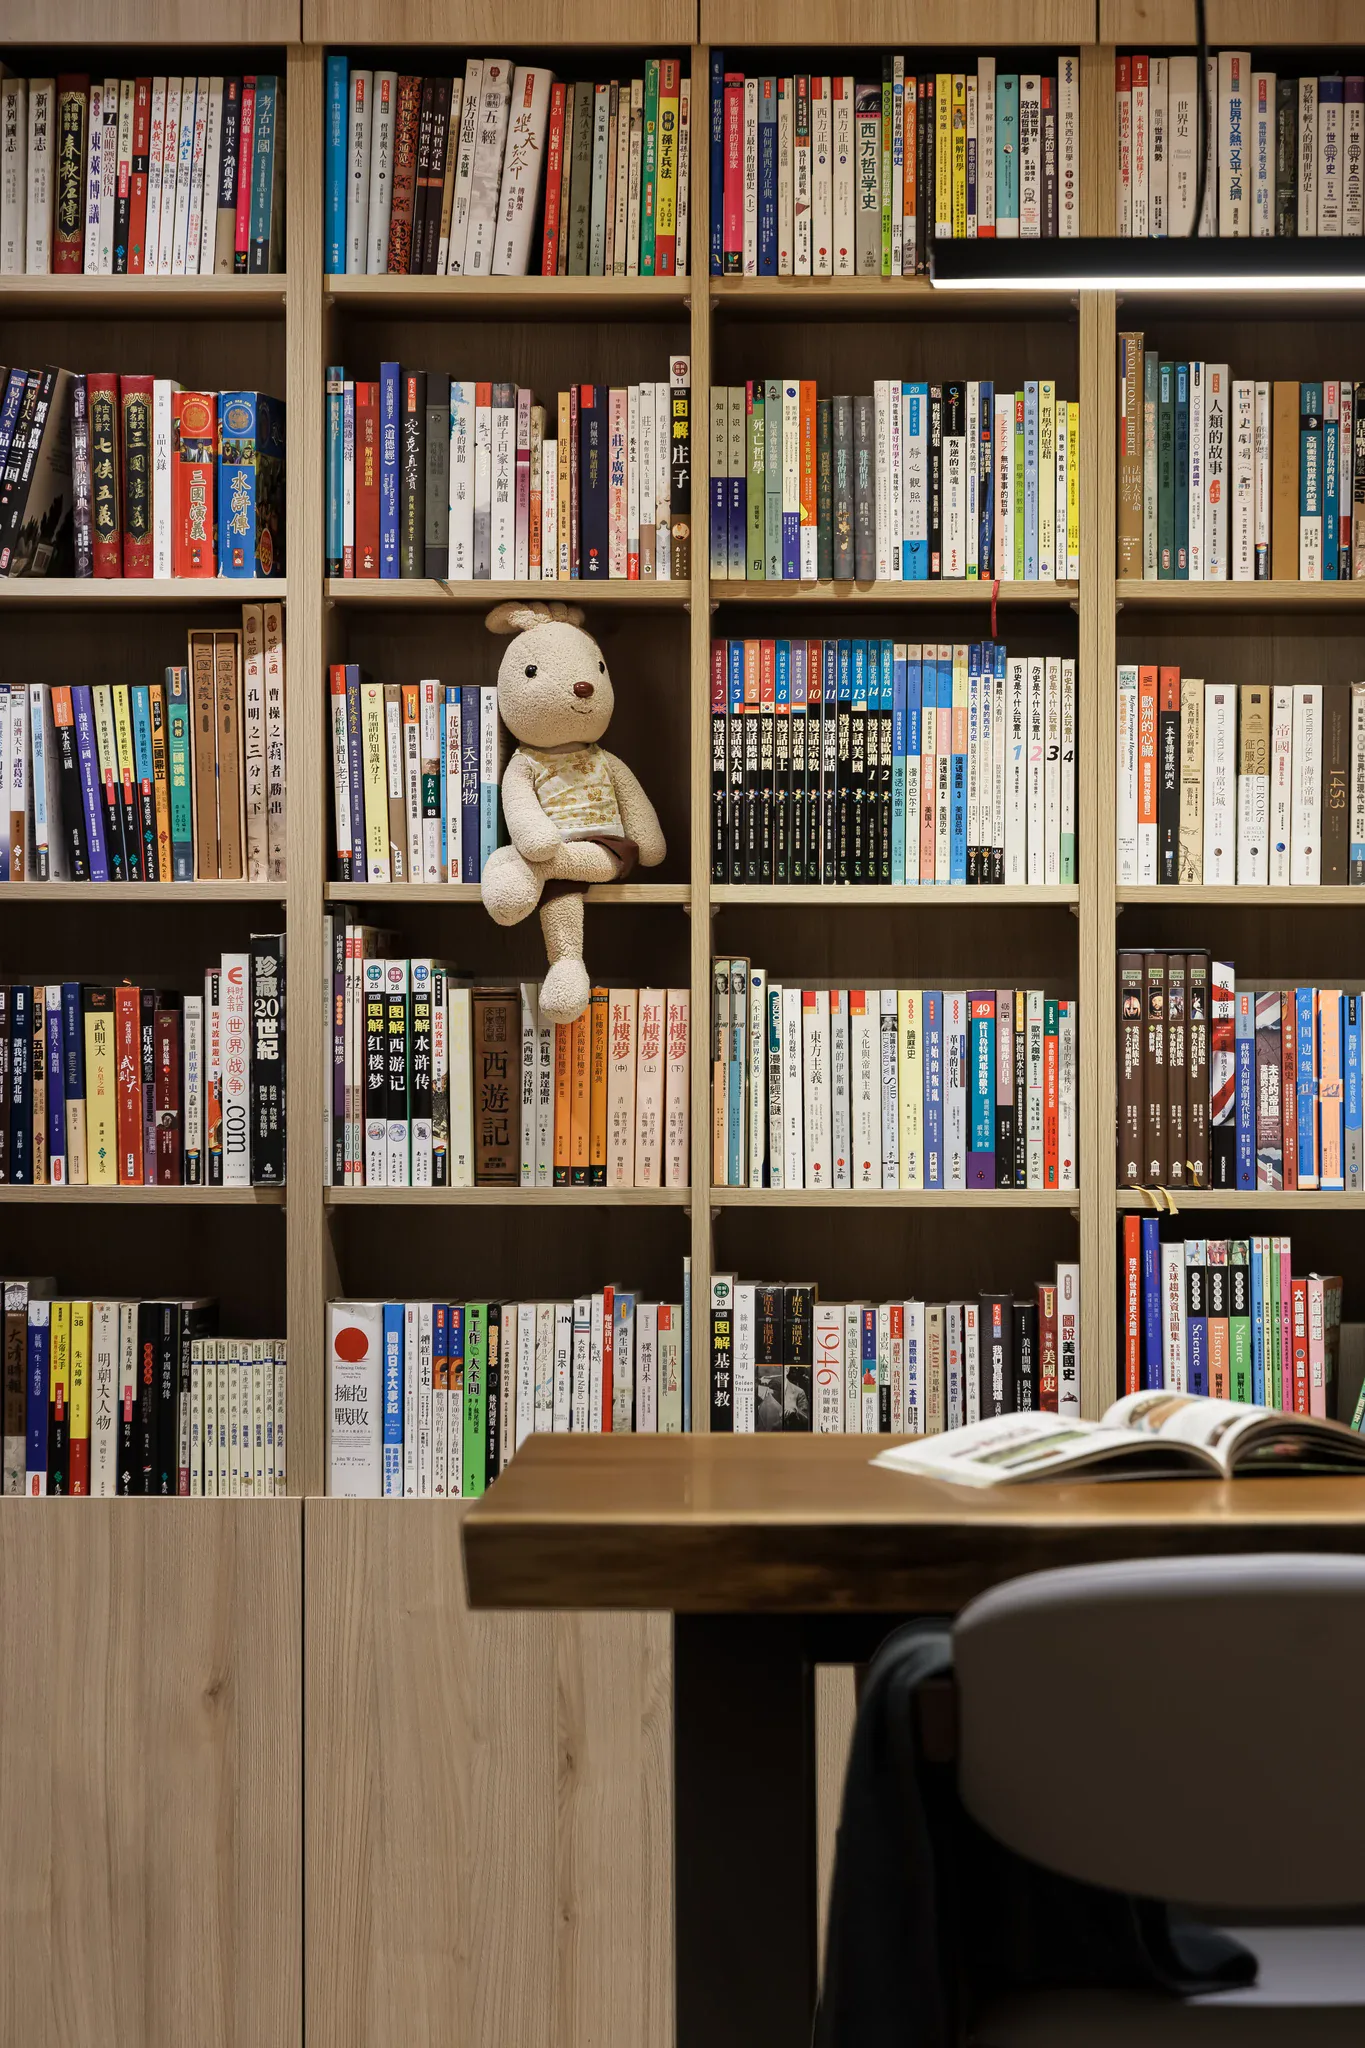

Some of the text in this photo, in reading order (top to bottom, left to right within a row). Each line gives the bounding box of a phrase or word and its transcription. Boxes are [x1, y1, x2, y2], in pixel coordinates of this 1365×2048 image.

[5, 93, 17, 153] 新列國志
[34, 93, 47, 152] 新列國志
[258, 96, 274, 154] 考古中國
[420, 111, 432, 167] 中国哲学史
[432, 114, 444, 170] 中国哲学史
[462, 97, 477, 143] 東方思想
[481, 110, 497, 145] 五經
[729, 97, 738, 169] 影響世界的哲學家
[817, 108, 828, 155] 西方正典
[838, 108, 848, 155] 西方正典
[1177, 101, 1188, 137] 世界史
[354, 123, 363, 167] 哲學與人生
[379, 123, 388, 168] 哲學與人生
[508, 113, 539, 180] 樂天知命
[660, 134, 673, 179] 孫子兵法
[763, 127, 773, 199] 如何讀西方正典
[861, 123, 877, 209] 西方哲学史
[1127, 340, 1135, 404] REVOLUTION
[21, 389, 37, 420] 易中天
[716, 403, 724, 442] 知识论
[732, 403, 740, 442] 知识论
[156, 433, 166, 471] 品人錄
[457, 417, 466, 463] 老子的幫助
[497, 415, 508, 503] 諸子百家大解讀
[753, 419, 764, 473] 死亡哲學
[949, 440, 959, 484] 叛逆的靈魂
[1208, 399, 1223, 475] 人類的故事
[94, 437, 113, 527] 七俠五義
[909, 448, 921, 502] 靜心觀照
[1000, 456, 1008, 516] 無所事事的哲學
[190, 471, 206, 540] 三國演義
[231, 472, 251, 535] 水滸傳
[715, 689, 723, 699] 2
[732, 690, 741, 699] 3
[747, 689, 757, 699] 5
[764, 688, 772, 698] 7
[778, 689, 787, 699] 8
[795, 688, 803, 698] 9
[808, 689, 820, 699] 10
[825, 690, 835, 699] 11
[840, 689, 849, 698] 12
[853, 689, 865, 699] 13
[868, 687, 878, 696] 14
[881, 688, 892, 697] 15
[1013, 665, 1021, 740] 历史是个什么玩意儿
[1032, 666, 1040, 740] 历史是个什么玩意儿
[1047, 666, 1059, 760] 历史是个什么玩意儿 3
[1063, 669, 1074, 762] 历史是个什么玩意儿 4
[247, 689, 262, 814] 孔明之三分天下
[268, 689, 282, 813] 曹操之霸者勝出
[368, 712, 380, 784] 所謂的知識分子
[713, 719, 725, 772] 漫話英國
[730, 719, 742, 784] 漫話義大利
[746, 719, 757, 771] 漫話德國
[761, 718, 772, 771] 漫話韓國
[777, 720, 788, 771] 漫話瑞士
[793, 719, 804, 771] 漫話荷蘭
[808, 720, 820, 771] 漫話宗教
[824, 720, 835, 772] 漫話神話
[839, 714, 849, 761] 漫話哲學
[852, 719, 864, 773] 漫話美國
[867, 719, 878, 766] 漫話歐洲
[881, 719, 892, 765] 漫話歐洲
[1141, 696, 1153, 757] 歐洲的心臟
[13, 759, 22, 789] 諸葛亮
[462, 747, 478, 804] 天工開物
[1031, 746, 1042, 760] 2
[1165, 721, 1175, 789] 一本書讀懂歐洲史
[1245, 740, 1255, 775] 征服者
[895, 768, 903, 817] 漫话东南亚
[1216, 766, 1226, 806] 財富之城
[1256, 739, 1265, 823] CONQUERORS
[1304, 766, 1314, 805] 海洋帝國
[1330, 769, 1345, 809] 1453
[255, 957, 279, 1060] 珍藏20世紀
[612, 1004, 631, 1061] 紅樓夢
[641, 1004, 660, 1061] 紅樓夢
[668, 1004, 687, 1060] 紅樓夢
[976, 1004, 990, 1015] 49
[94, 1020, 106, 1056] 武則天
[811, 1031, 822, 1084] 東方主義
[950, 1035, 958, 1088] 革命的年代
[1132, 1026, 1140, 1066] 英語民族史
[1301, 1010, 1312, 1071] 帝国边缘
[862, 1029, 870, 1100] 文化與帝國主義
[1285, 1053, 1293, 1080] 英國史
[482, 1050, 510, 1146] 西遊記
[1169, 1263, 1179, 1341] 全球趨勢資訊圖集
[74, 1351, 82, 1386] 朱元璋傳
[619, 1327, 628, 1365] 灣生回家
[641, 1343, 651, 1382] 裸體日本
[817, 1326, 839, 1385] 1946
[1063, 1315, 1075, 1380] 圖說美國史
[1192, 1324, 1203, 1366] Science
[1214, 1325, 1224, 1368] History
[1236, 1324, 1244, 1363] Nature
[96, 1353, 111, 1430] 明朝大人物
[335, 1384, 368, 1402] 擁抱
[387, 1332, 399, 1413] 圖說日本大事記
[1043, 1350, 1055, 1392] 美國史
[335, 1407, 368, 1425] 戰敗
